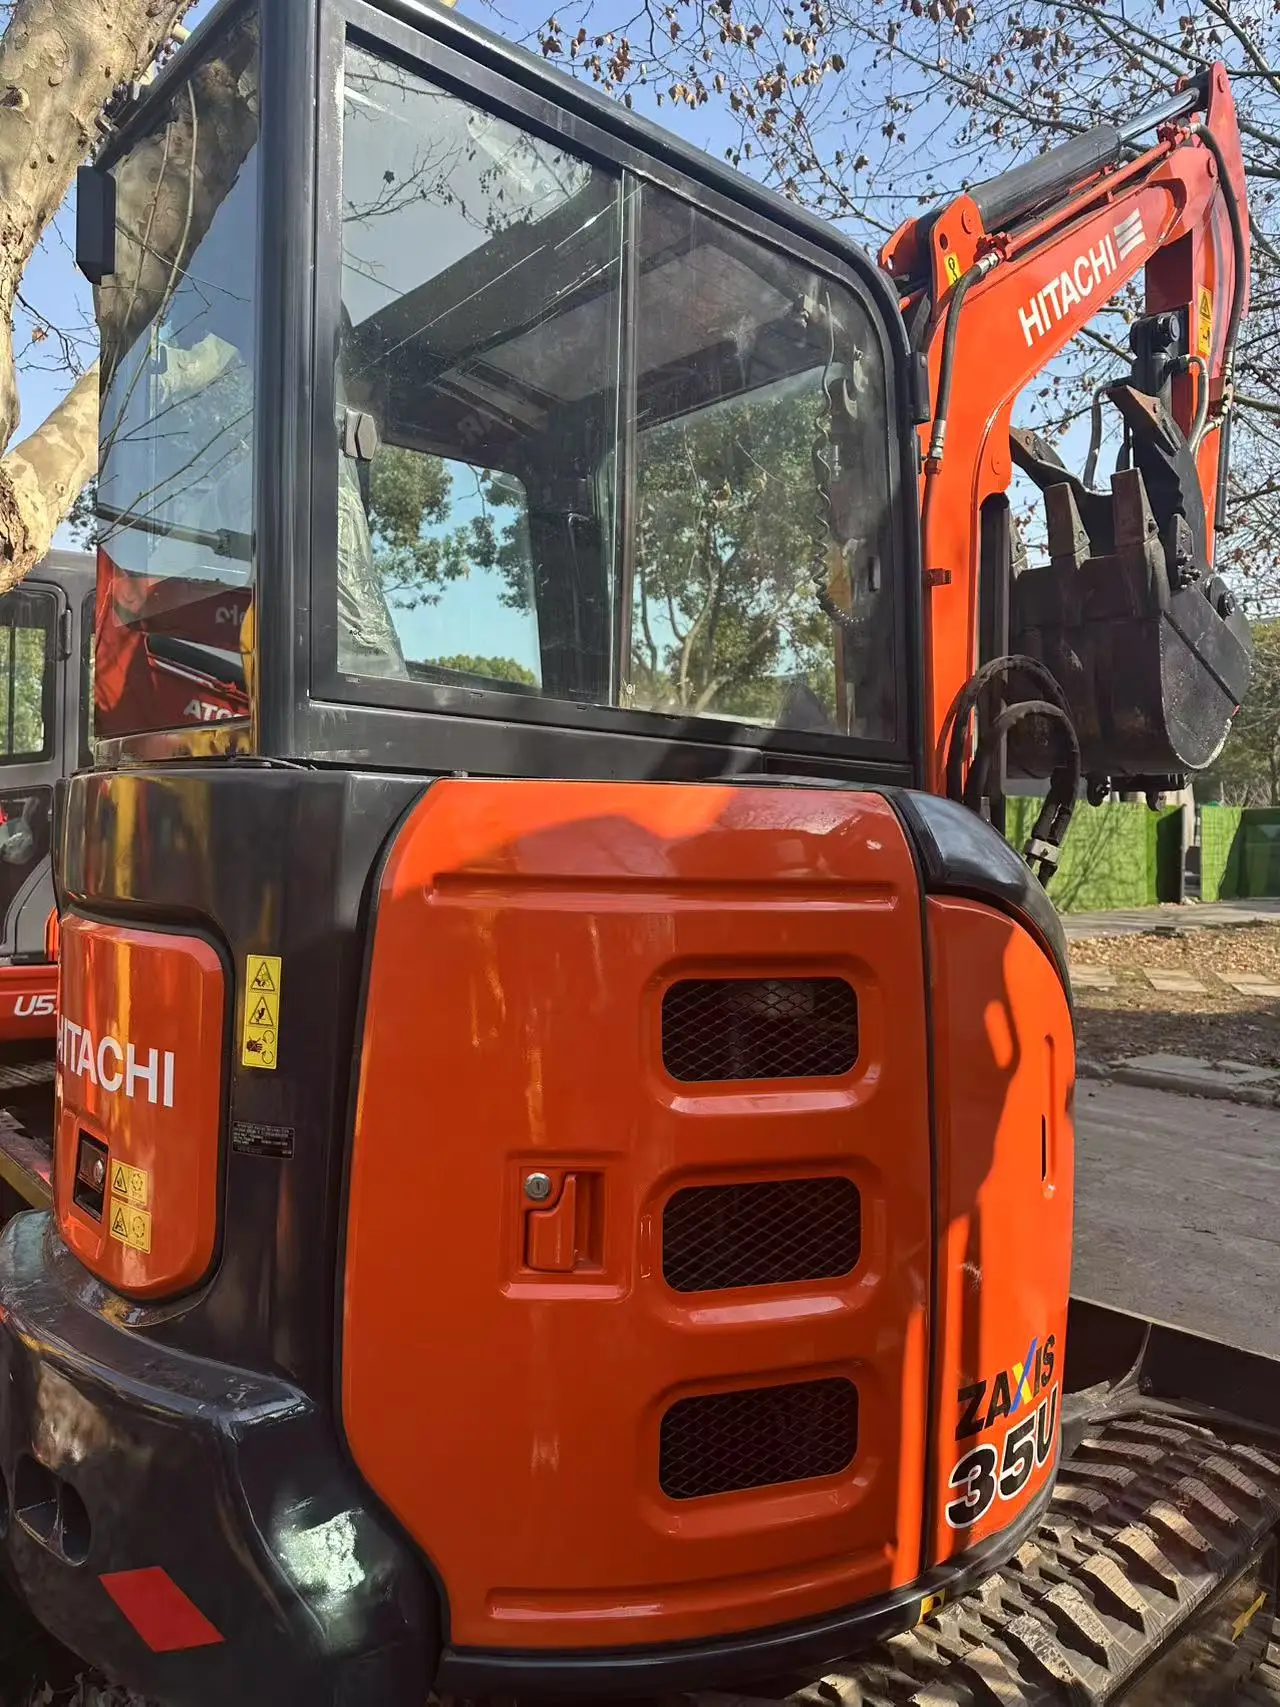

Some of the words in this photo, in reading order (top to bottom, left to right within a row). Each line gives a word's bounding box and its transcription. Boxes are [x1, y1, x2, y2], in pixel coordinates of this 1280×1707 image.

[1018, 233, 1117, 348] HITACHI
[14, 994, 57, 1016] U5
[57, 1014, 175, 1108] HITACHI
[955, 1334, 1055, 1441] ZAXIS
[945, 1379, 1059, 1528] 35U
